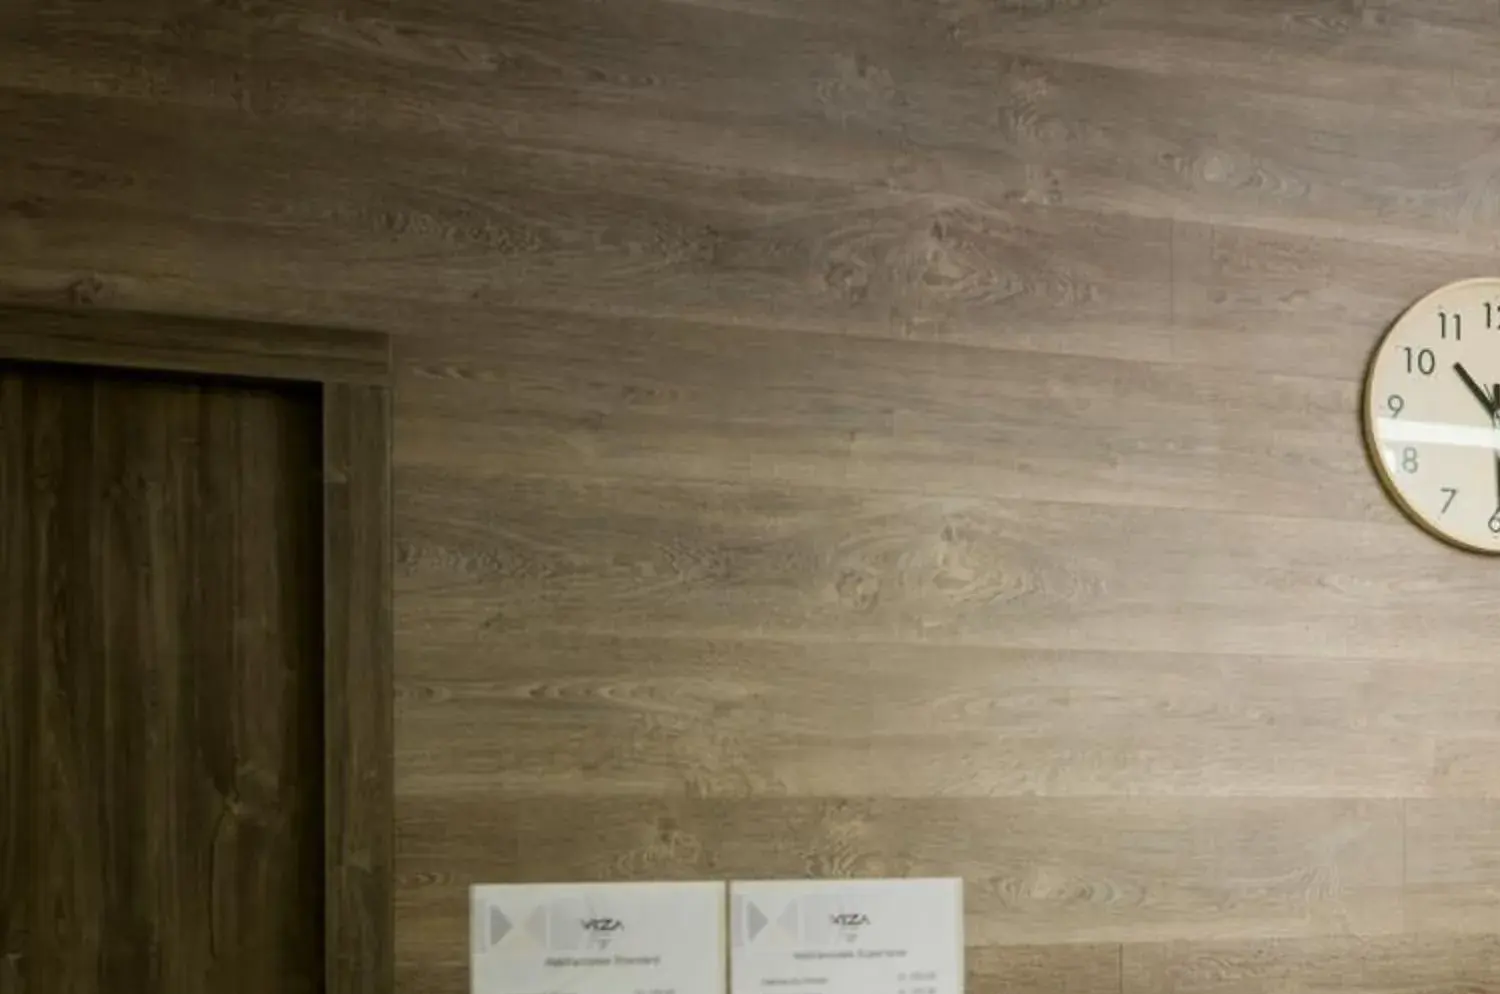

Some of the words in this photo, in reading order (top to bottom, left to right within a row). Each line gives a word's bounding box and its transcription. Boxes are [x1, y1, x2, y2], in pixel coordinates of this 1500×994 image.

[1437, 311, 1462, 341] 11
[1403, 346, 1436, 375] 10
[1386, 394, 1405, 419] 9
[1401, 446, 1420, 474] 8
[1440, 487, 1459, 514] 7
